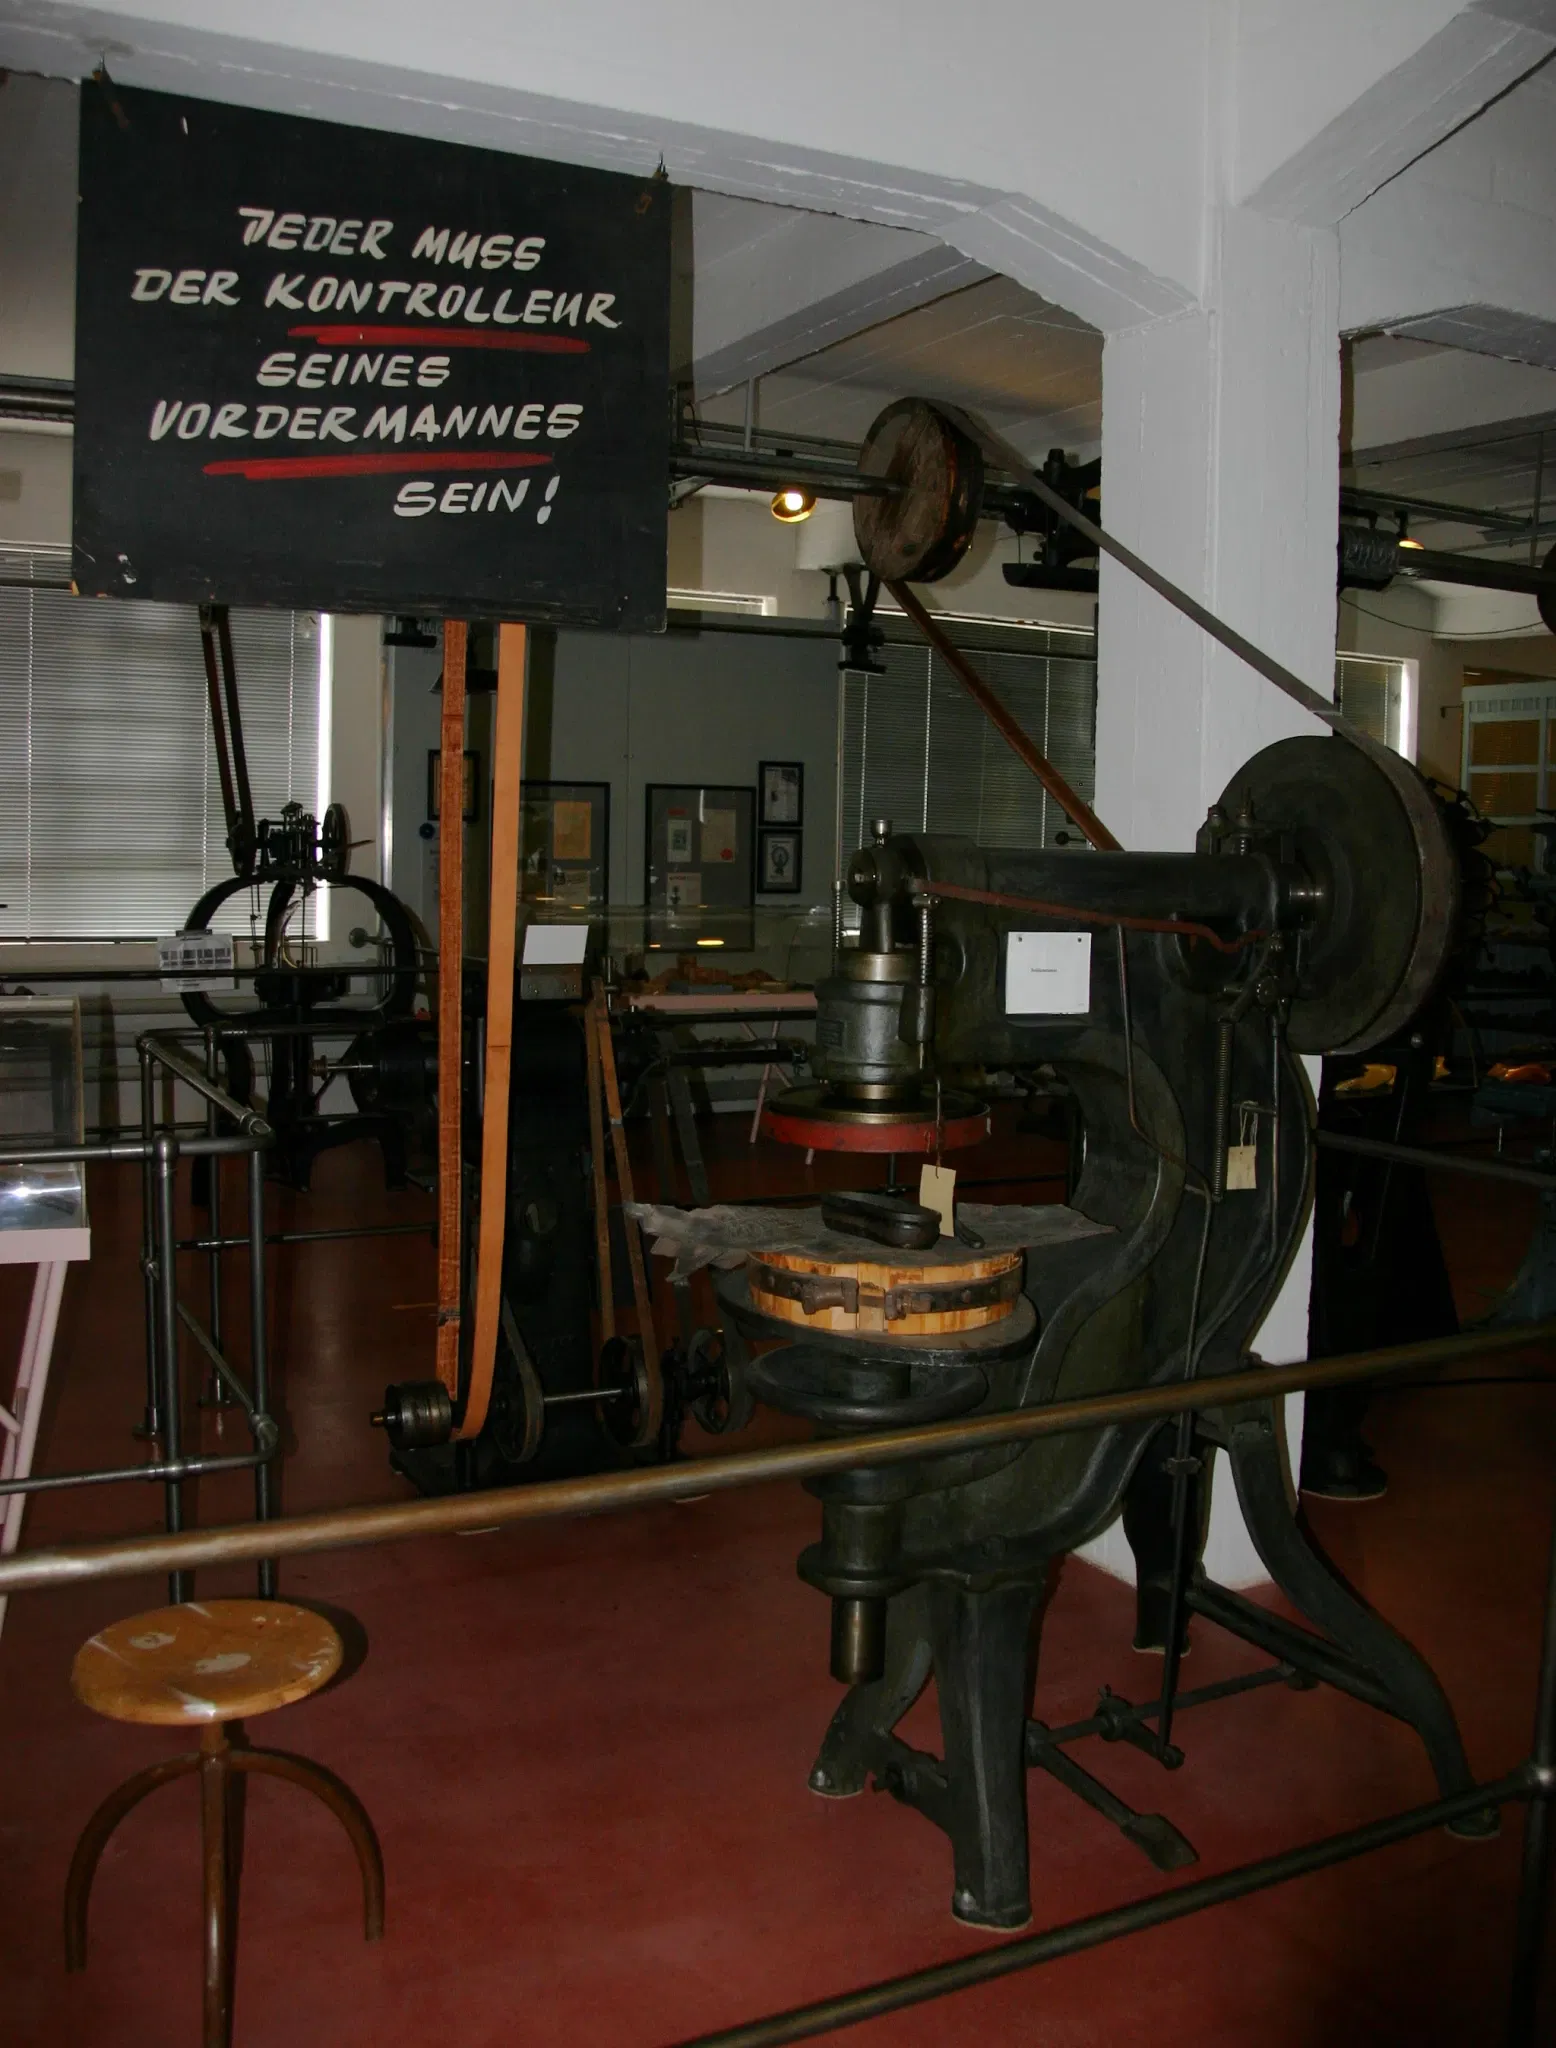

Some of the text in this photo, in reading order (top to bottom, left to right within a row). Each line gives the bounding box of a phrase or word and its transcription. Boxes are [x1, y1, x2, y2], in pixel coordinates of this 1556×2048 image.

[238, 207, 546, 271] JEDER MUSS
[131, 269, 620, 329] DER KONTROLLEUR
[256, 352, 451, 389] SEINES
[149, 400, 584, 444] VORDERMANNES
[393, 475, 561, 525] SEIN!
